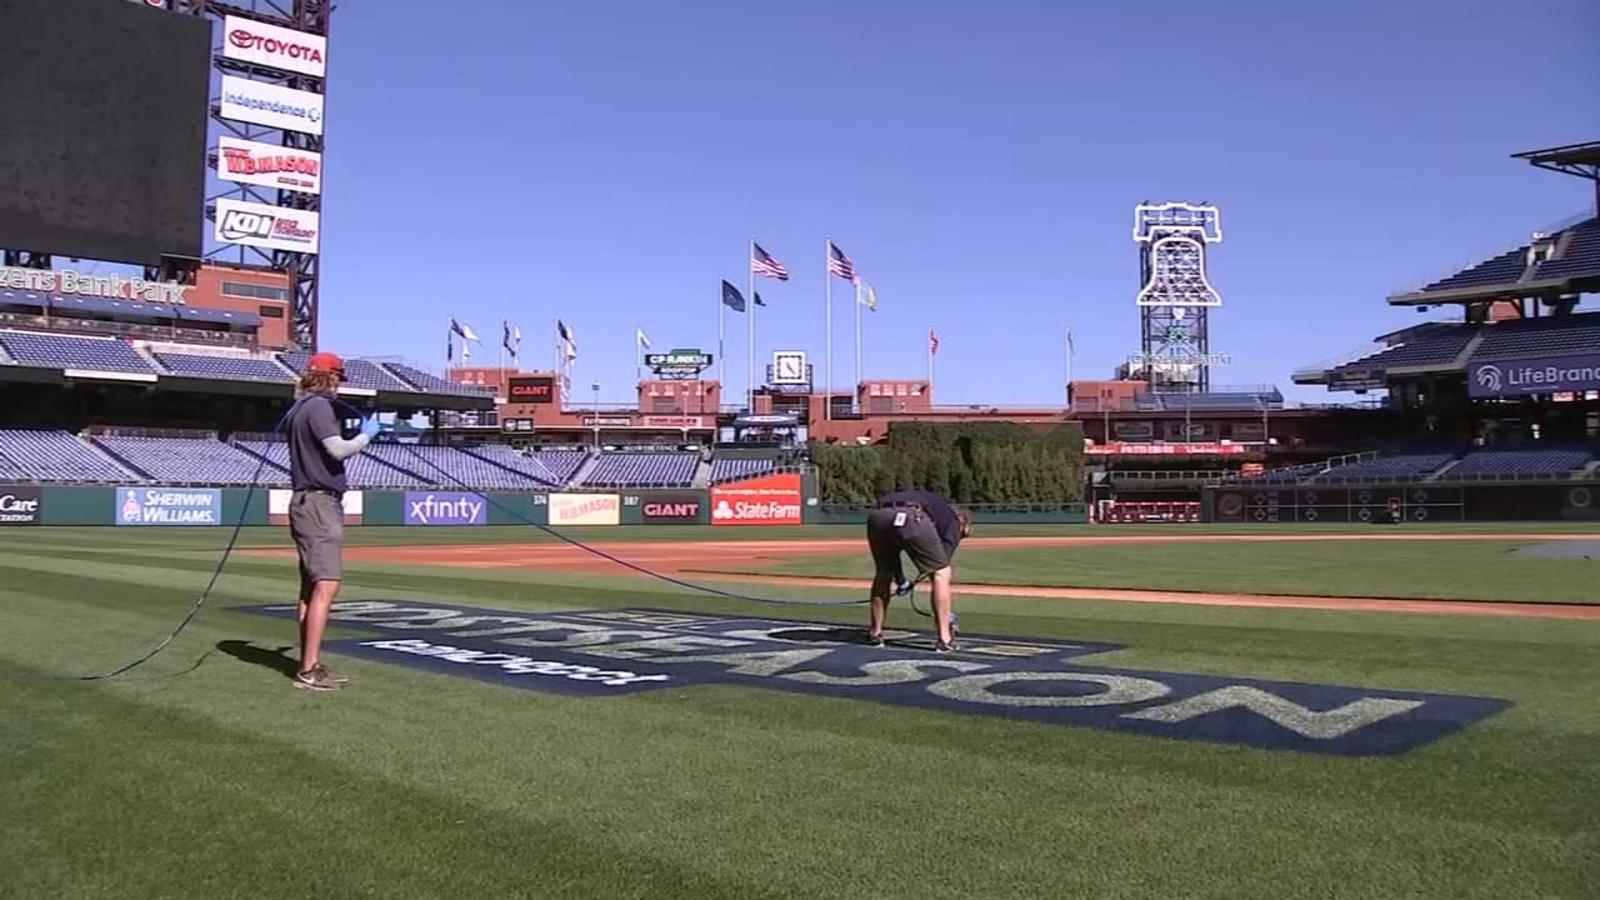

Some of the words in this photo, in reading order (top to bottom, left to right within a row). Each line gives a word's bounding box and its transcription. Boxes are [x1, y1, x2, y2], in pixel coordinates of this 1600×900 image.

[252, 35, 322, 63] TOYOTA
[225, 92, 306, 118] Independence
[222, 210, 274, 238] KDI
[61, 269, 125, 298] Bank
[130, 276, 186, 305] Park
[512, 386, 549, 395] GIANT
[0, 494, 38, 511] Care
[144, 490, 213, 506] SHERWIN
[410, 495, 482, 523] xfinity
[644, 503, 699, 516] GIANT
[262, 601, 1426, 740] POSTSEASON
